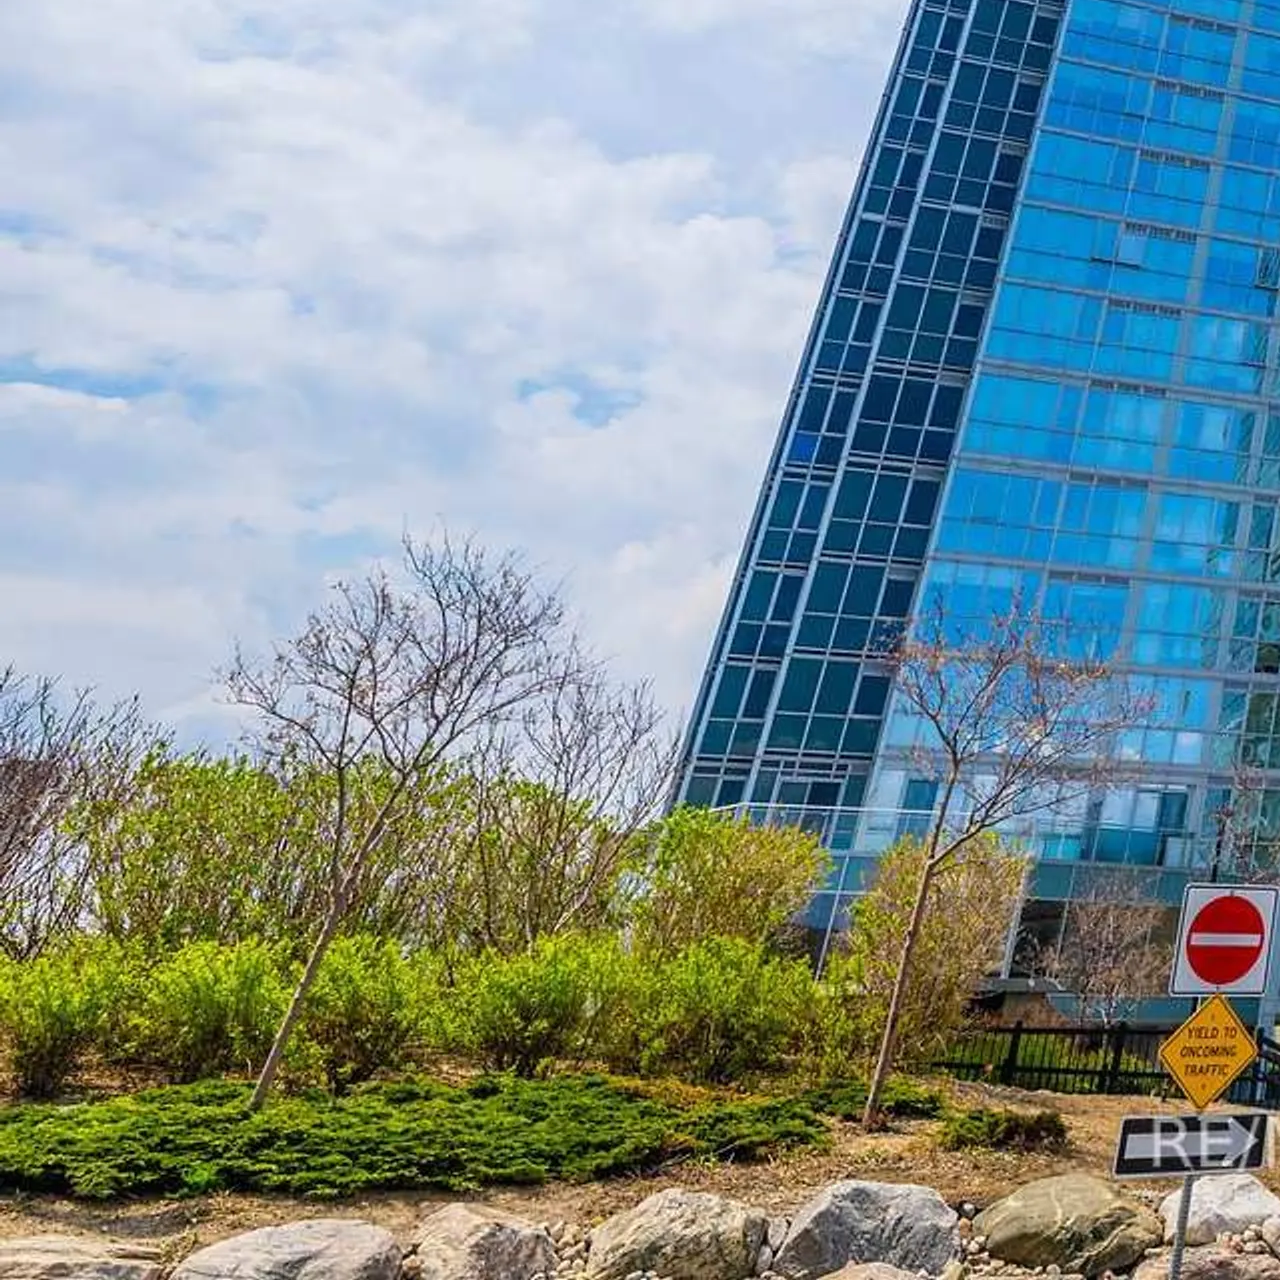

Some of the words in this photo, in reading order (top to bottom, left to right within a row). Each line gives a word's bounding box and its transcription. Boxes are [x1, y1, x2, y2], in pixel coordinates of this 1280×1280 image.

[1187, 1026, 1219, 1039] YIELD
[1224, 1026, 1237, 1039] TO
[1180, 1045, 1237, 1057] ONCOMING
[1184, 1064, 1229, 1076] TRAFFIC
